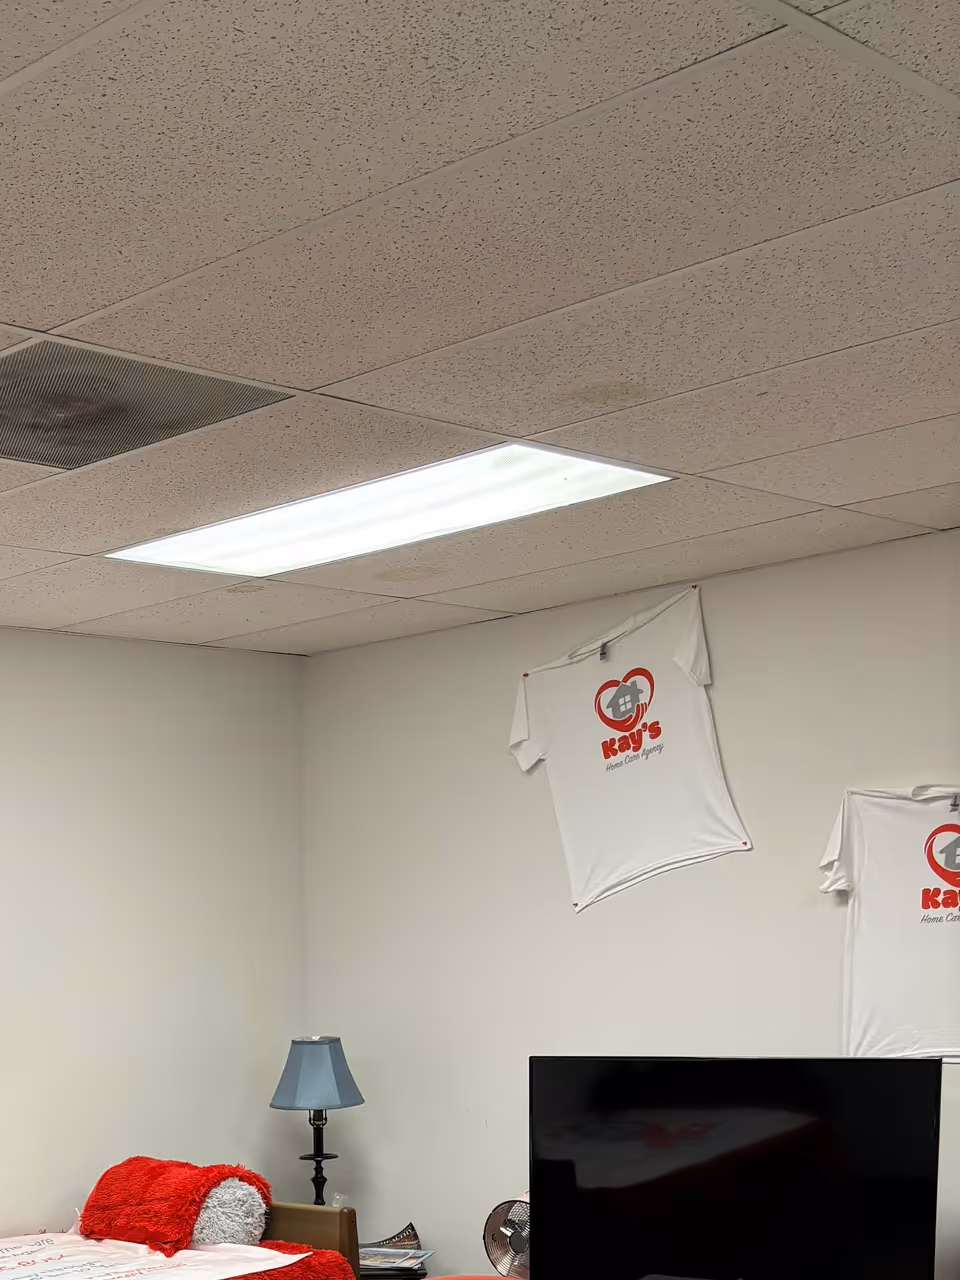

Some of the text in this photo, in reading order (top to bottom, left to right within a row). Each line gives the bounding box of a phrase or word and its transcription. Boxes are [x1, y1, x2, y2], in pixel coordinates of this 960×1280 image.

[601, 721, 662, 760] Kay's
[606, 742, 664, 773] Home Care Agency
[921, 887, 960, 912] Ka
[920, 913, 944, 924] Home
